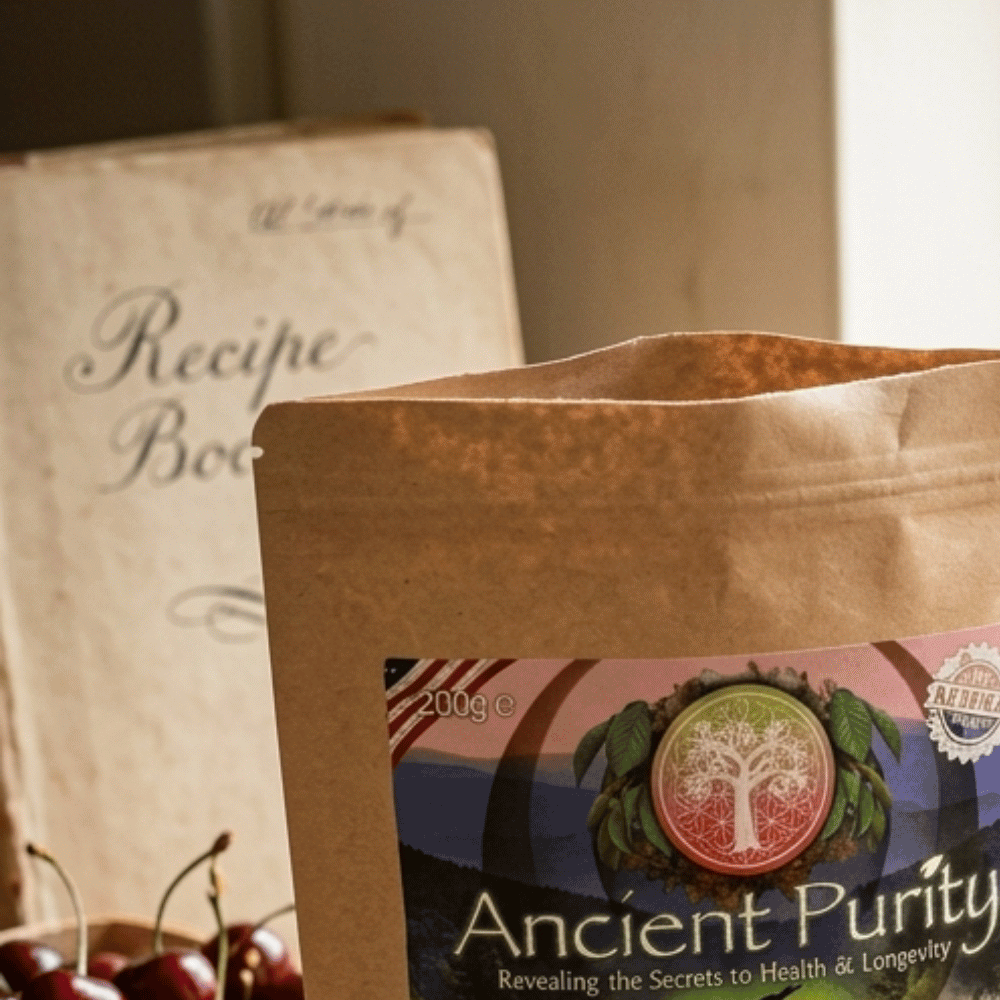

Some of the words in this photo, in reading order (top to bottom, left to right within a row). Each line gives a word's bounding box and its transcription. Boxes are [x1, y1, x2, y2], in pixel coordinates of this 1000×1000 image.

[62, 280, 378, 414] Recipe
[98, 397, 252, 495] Boo
[419, 690, 488, 723] 200g
[793, 853, 1000, 955] Purity
[498, 969, 600, 997] Revealing
[609, 970, 642, 991] the
[649, 968, 723, 990] Secrets
[730, 968, 751, 985] to
[760, 958, 827, 983] Health
[834, 955, 854, 976] &
[862, 938, 952, 973] Longevity
